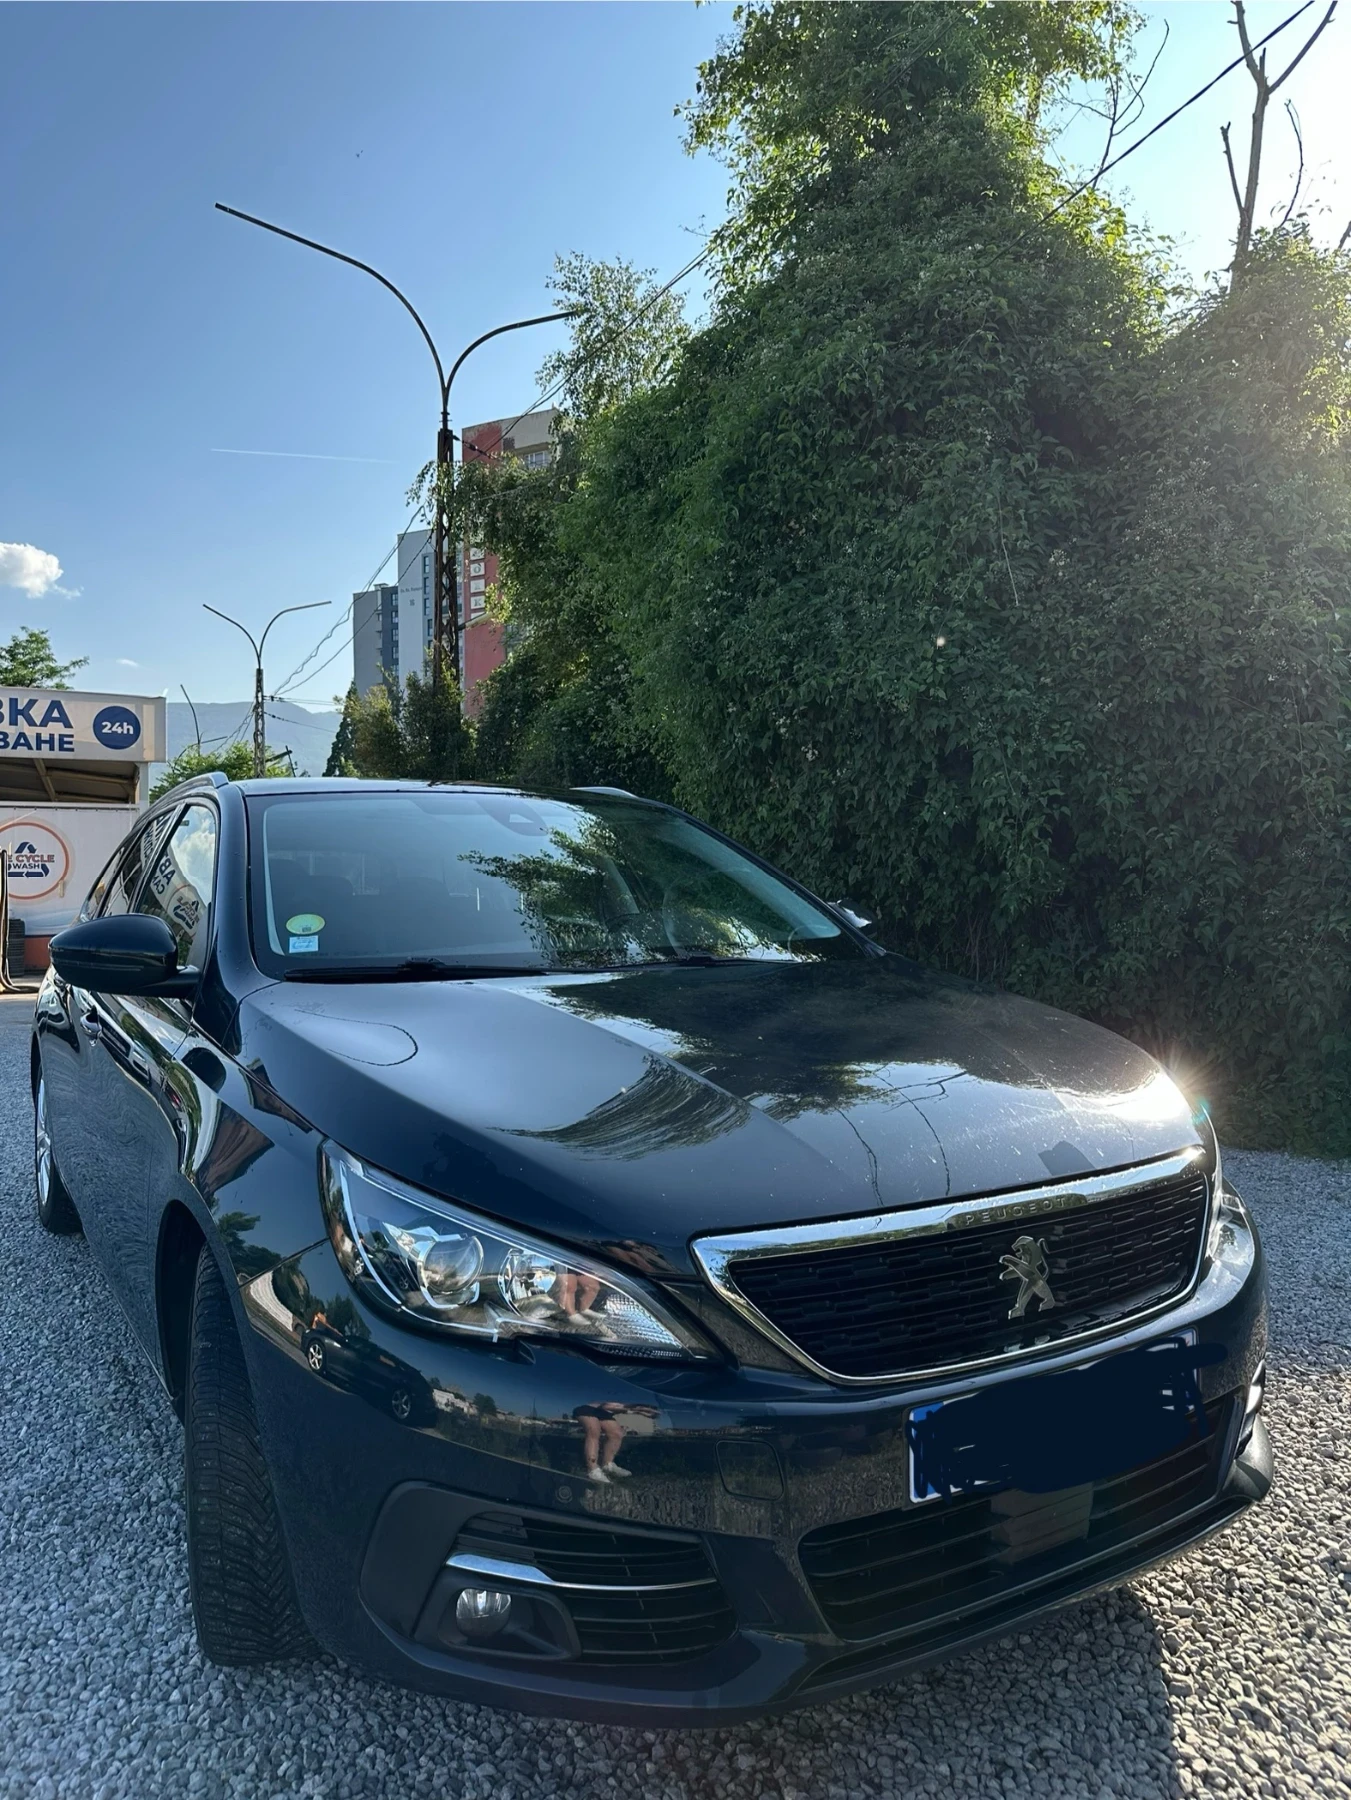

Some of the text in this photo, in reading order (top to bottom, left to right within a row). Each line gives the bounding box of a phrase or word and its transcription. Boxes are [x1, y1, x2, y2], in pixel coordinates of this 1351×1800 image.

[0, 697, 74, 729] КА
[101, 721, 134, 735] 24h
[16, 854, 55, 863] CYCLE
[965, 1198, 1066, 1226] PEUGEOT
